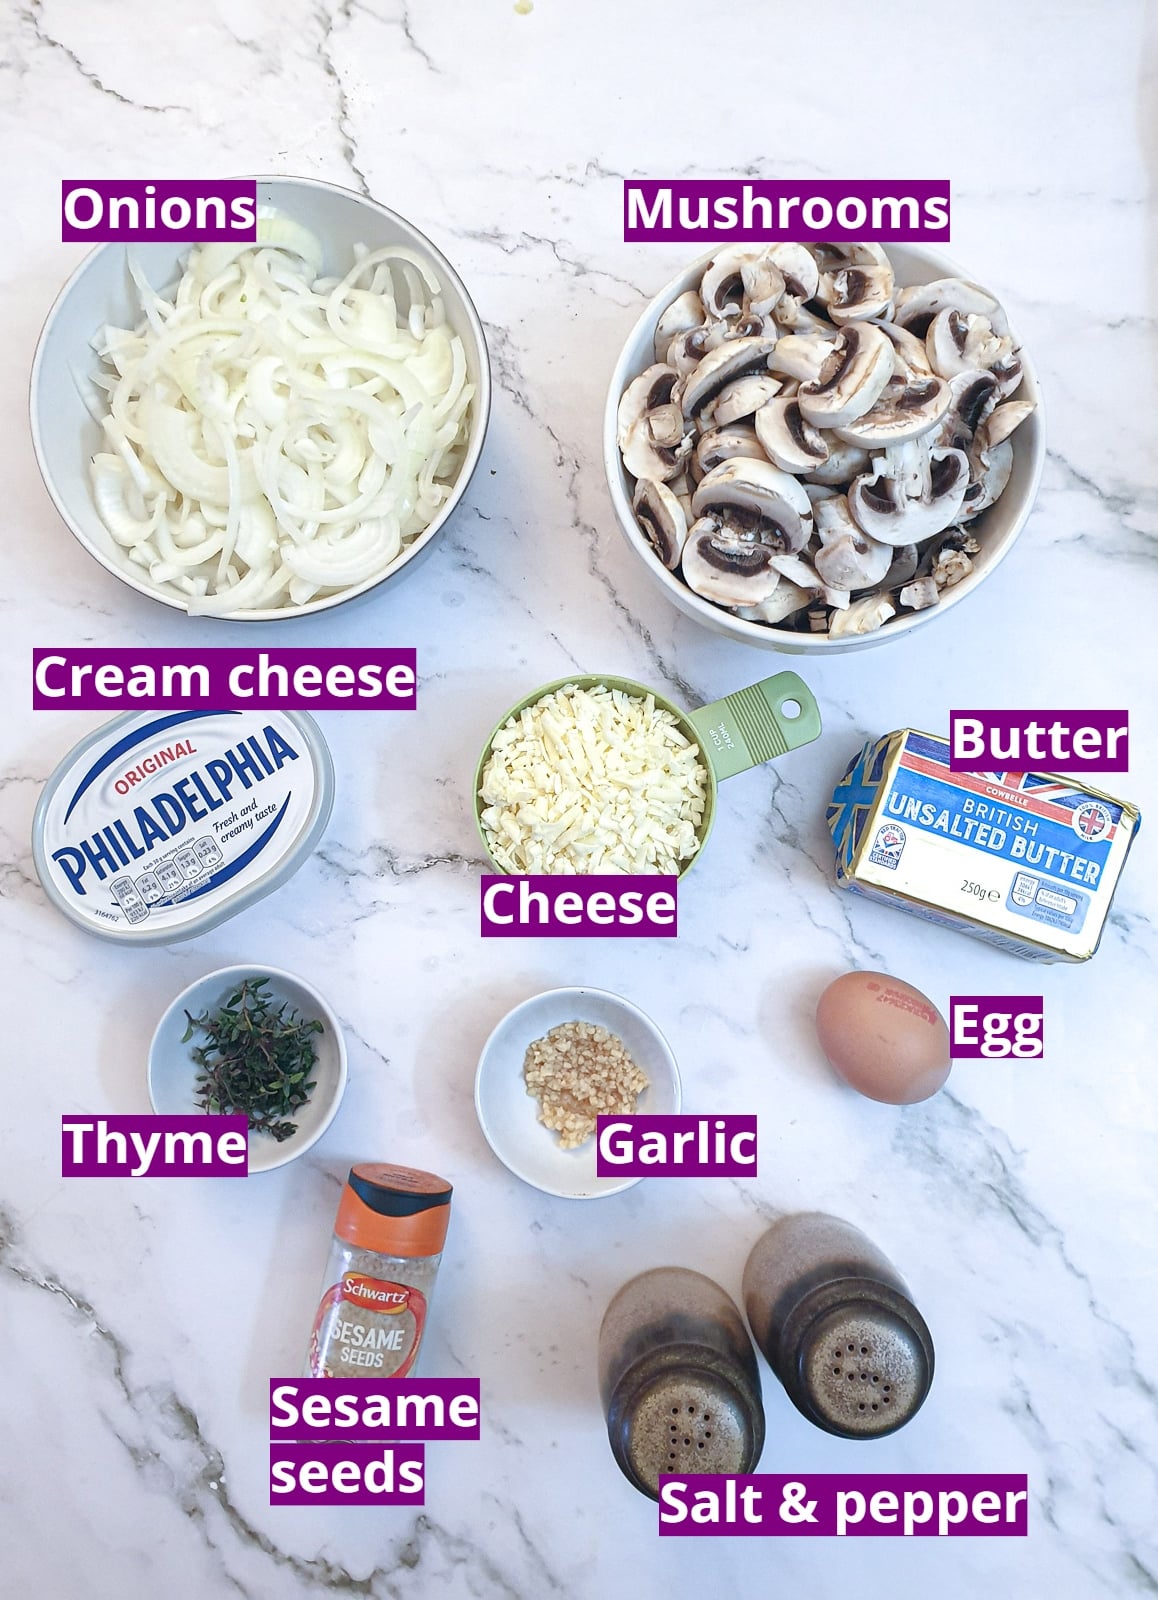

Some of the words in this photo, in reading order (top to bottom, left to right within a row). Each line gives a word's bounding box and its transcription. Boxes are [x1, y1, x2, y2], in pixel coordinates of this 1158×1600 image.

[709, 730, 721, 746] CUP
[113, 739, 198, 795] ORIGINAL
[986, 785, 1028, 806] COWBELLE
[51, 725, 300, 896] PHILADELPHIA
[212, 811, 239, 833] Fresh
[240, 797, 258, 816] and
[962, 798, 1040, 837] BRITISH
[221, 818, 254, 843] creamy
[255, 803, 278, 821] taste
[887, 791, 1006, 850] UNSALTED
[1009, 835, 1101, 886] BUTTER
[181, 860, 190, 869] 1.3
[198, 848, 211, 858] 0.23
[162, 872, 171, 881] 4.1
[171, 870, 177, 878] g
[142, 885, 152, 893] 6.2
[152, 882, 157, 890] g
[960, 880, 987, 901] 250g
[343, 1278, 406, 1303] Schwartz
[330, 1319, 405, 1351] SESAME
[340, 1346, 384, 1368] SEEDS
